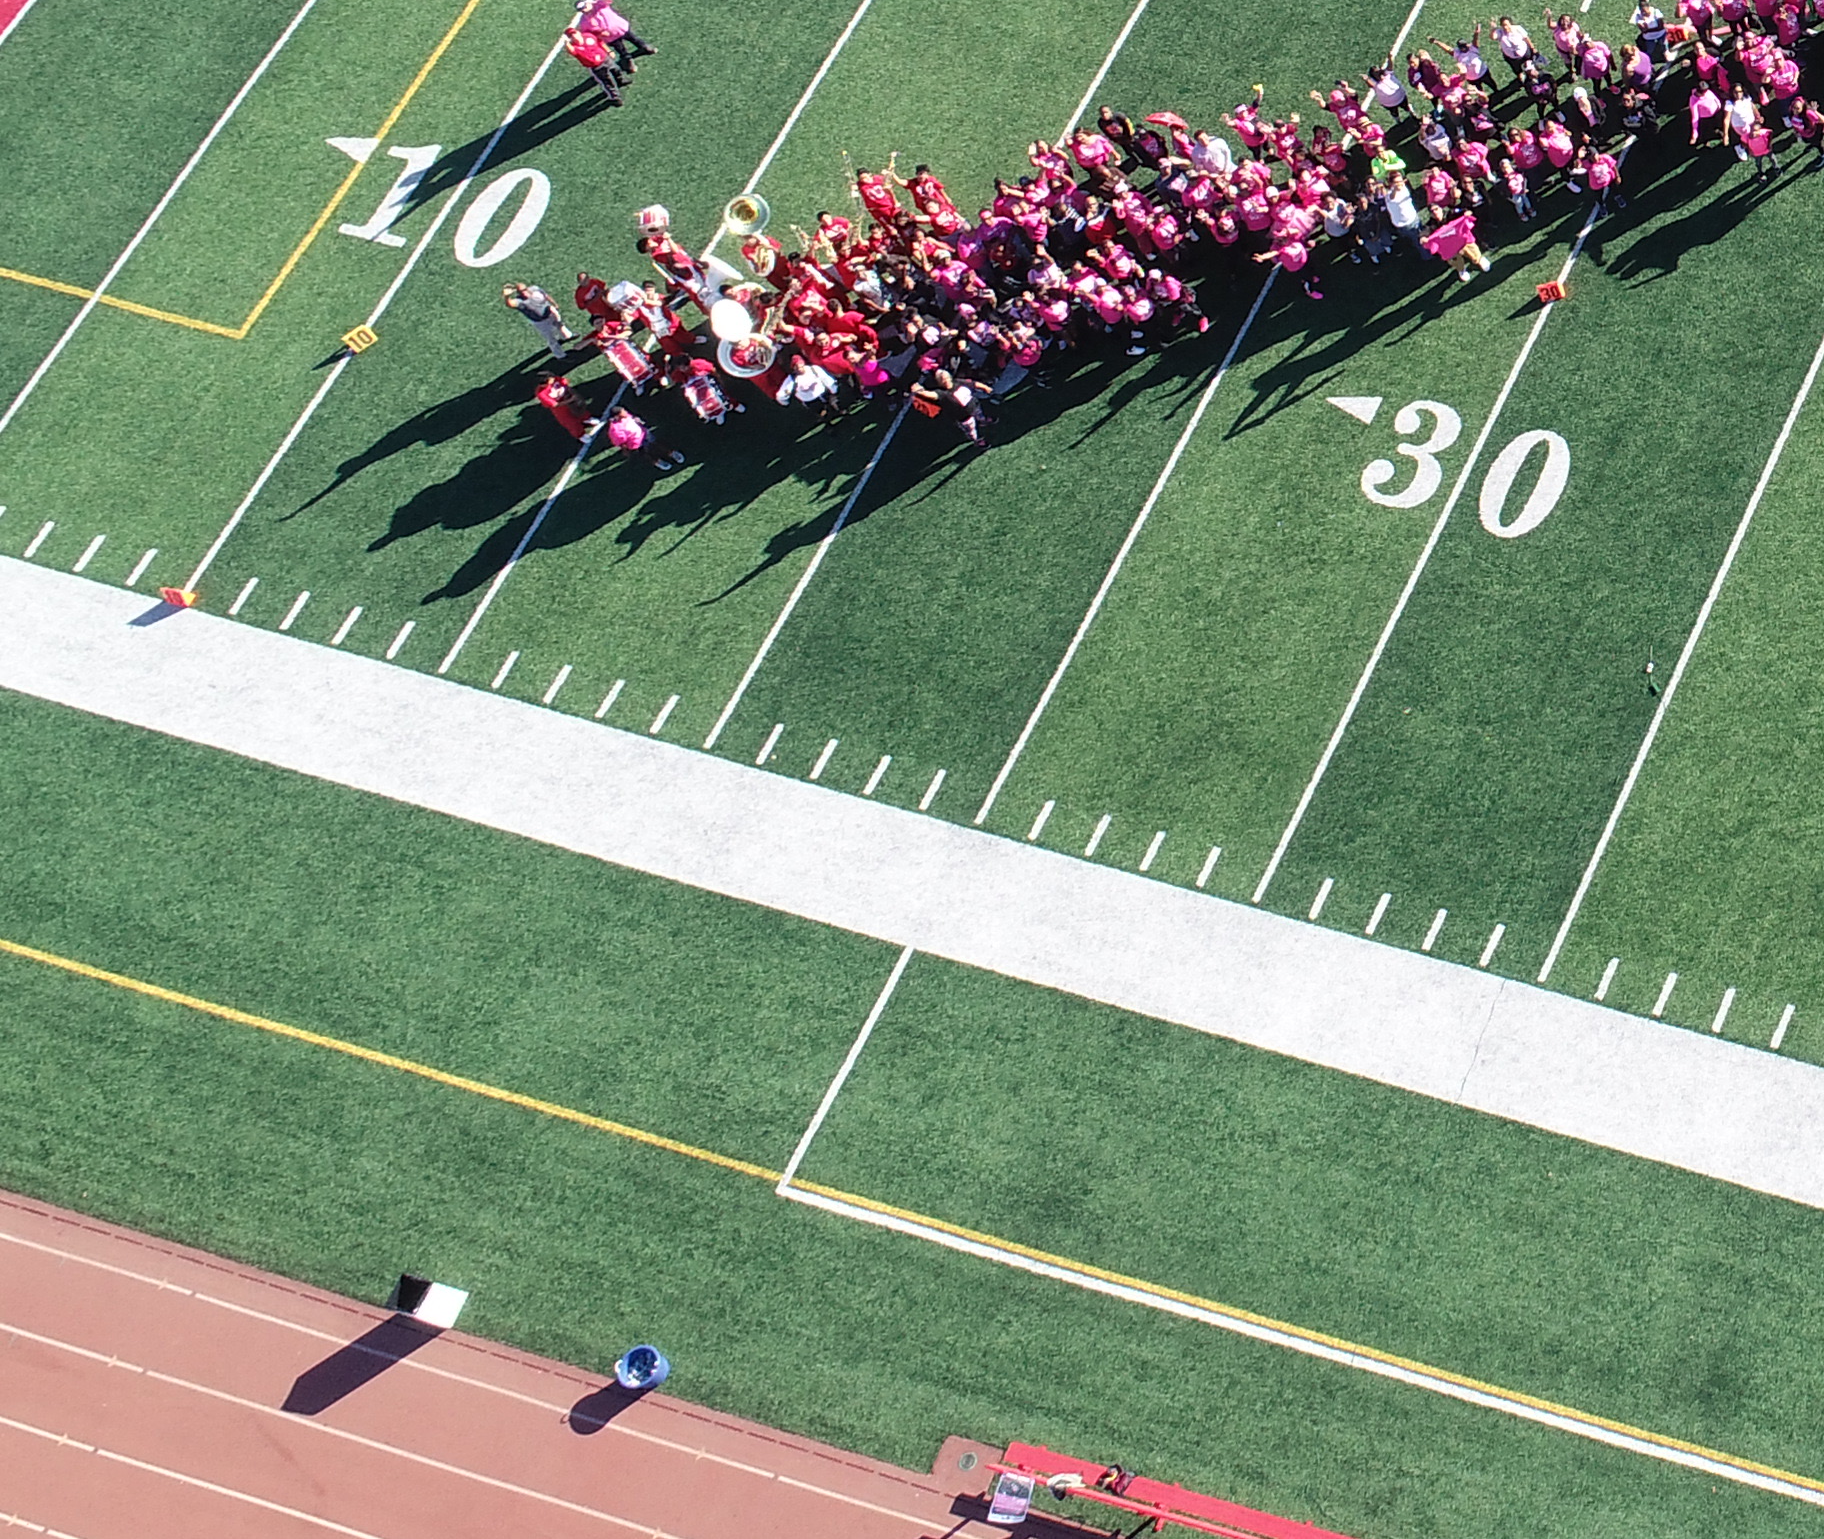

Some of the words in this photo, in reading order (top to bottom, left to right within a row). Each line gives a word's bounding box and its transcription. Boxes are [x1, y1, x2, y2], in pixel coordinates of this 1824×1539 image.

[338, 144, 550, 267] 10
[1540, 286, 1559, 301] 30
[349, 330, 374, 349] 10
[1361, 400, 1570, 538] 30
